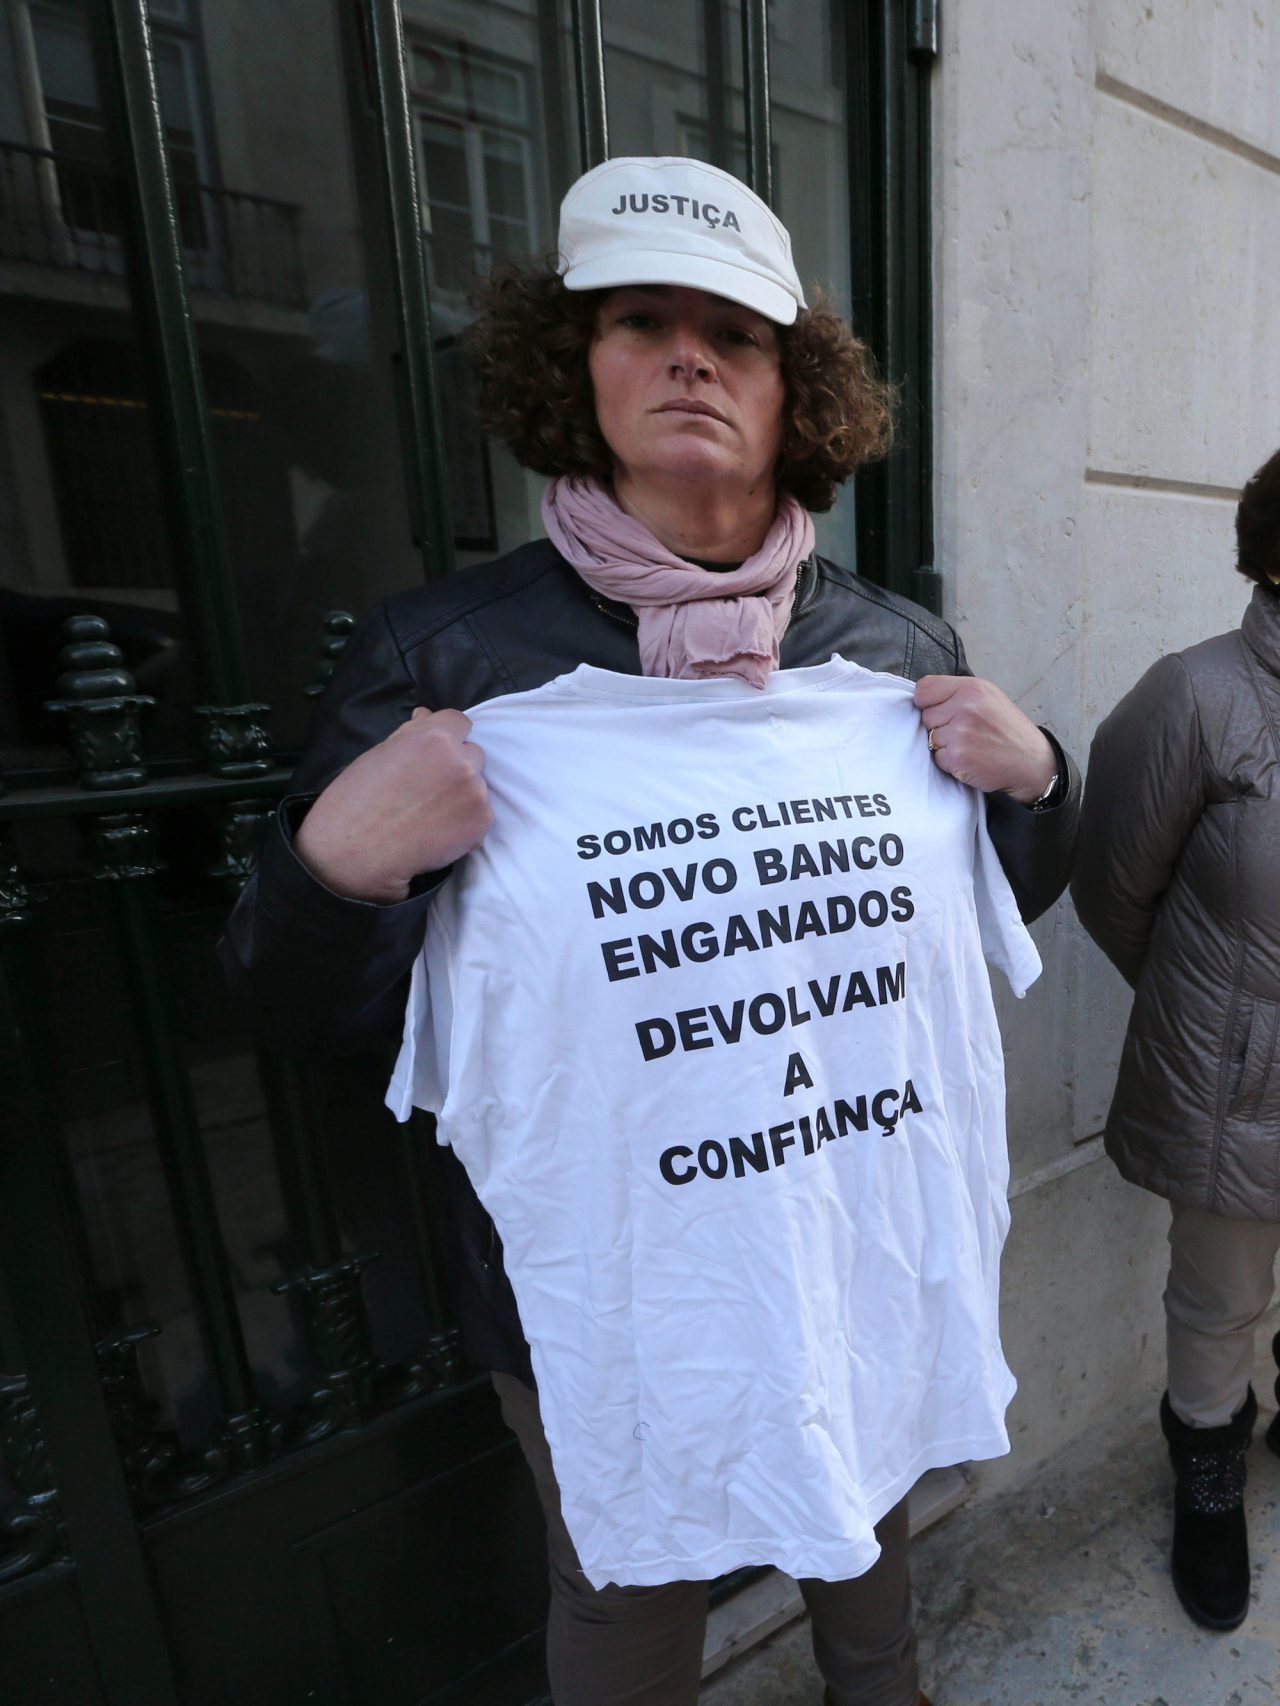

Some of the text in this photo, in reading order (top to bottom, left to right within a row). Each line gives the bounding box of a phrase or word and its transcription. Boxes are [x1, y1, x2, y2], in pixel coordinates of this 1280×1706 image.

[611, 193, 742, 232] JUSTIÇA
[577, 793, 892, 860] SOMOS CLIENTES
[586, 833, 905, 919] NOVO BANCO
[600, 886, 915, 982] ENGANADOS
[635, 962, 906, 1062] DEVOLVAM
[783, 1052, 814, 1097] A
[659, 1079, 924, 1186] CONFIANÇA
